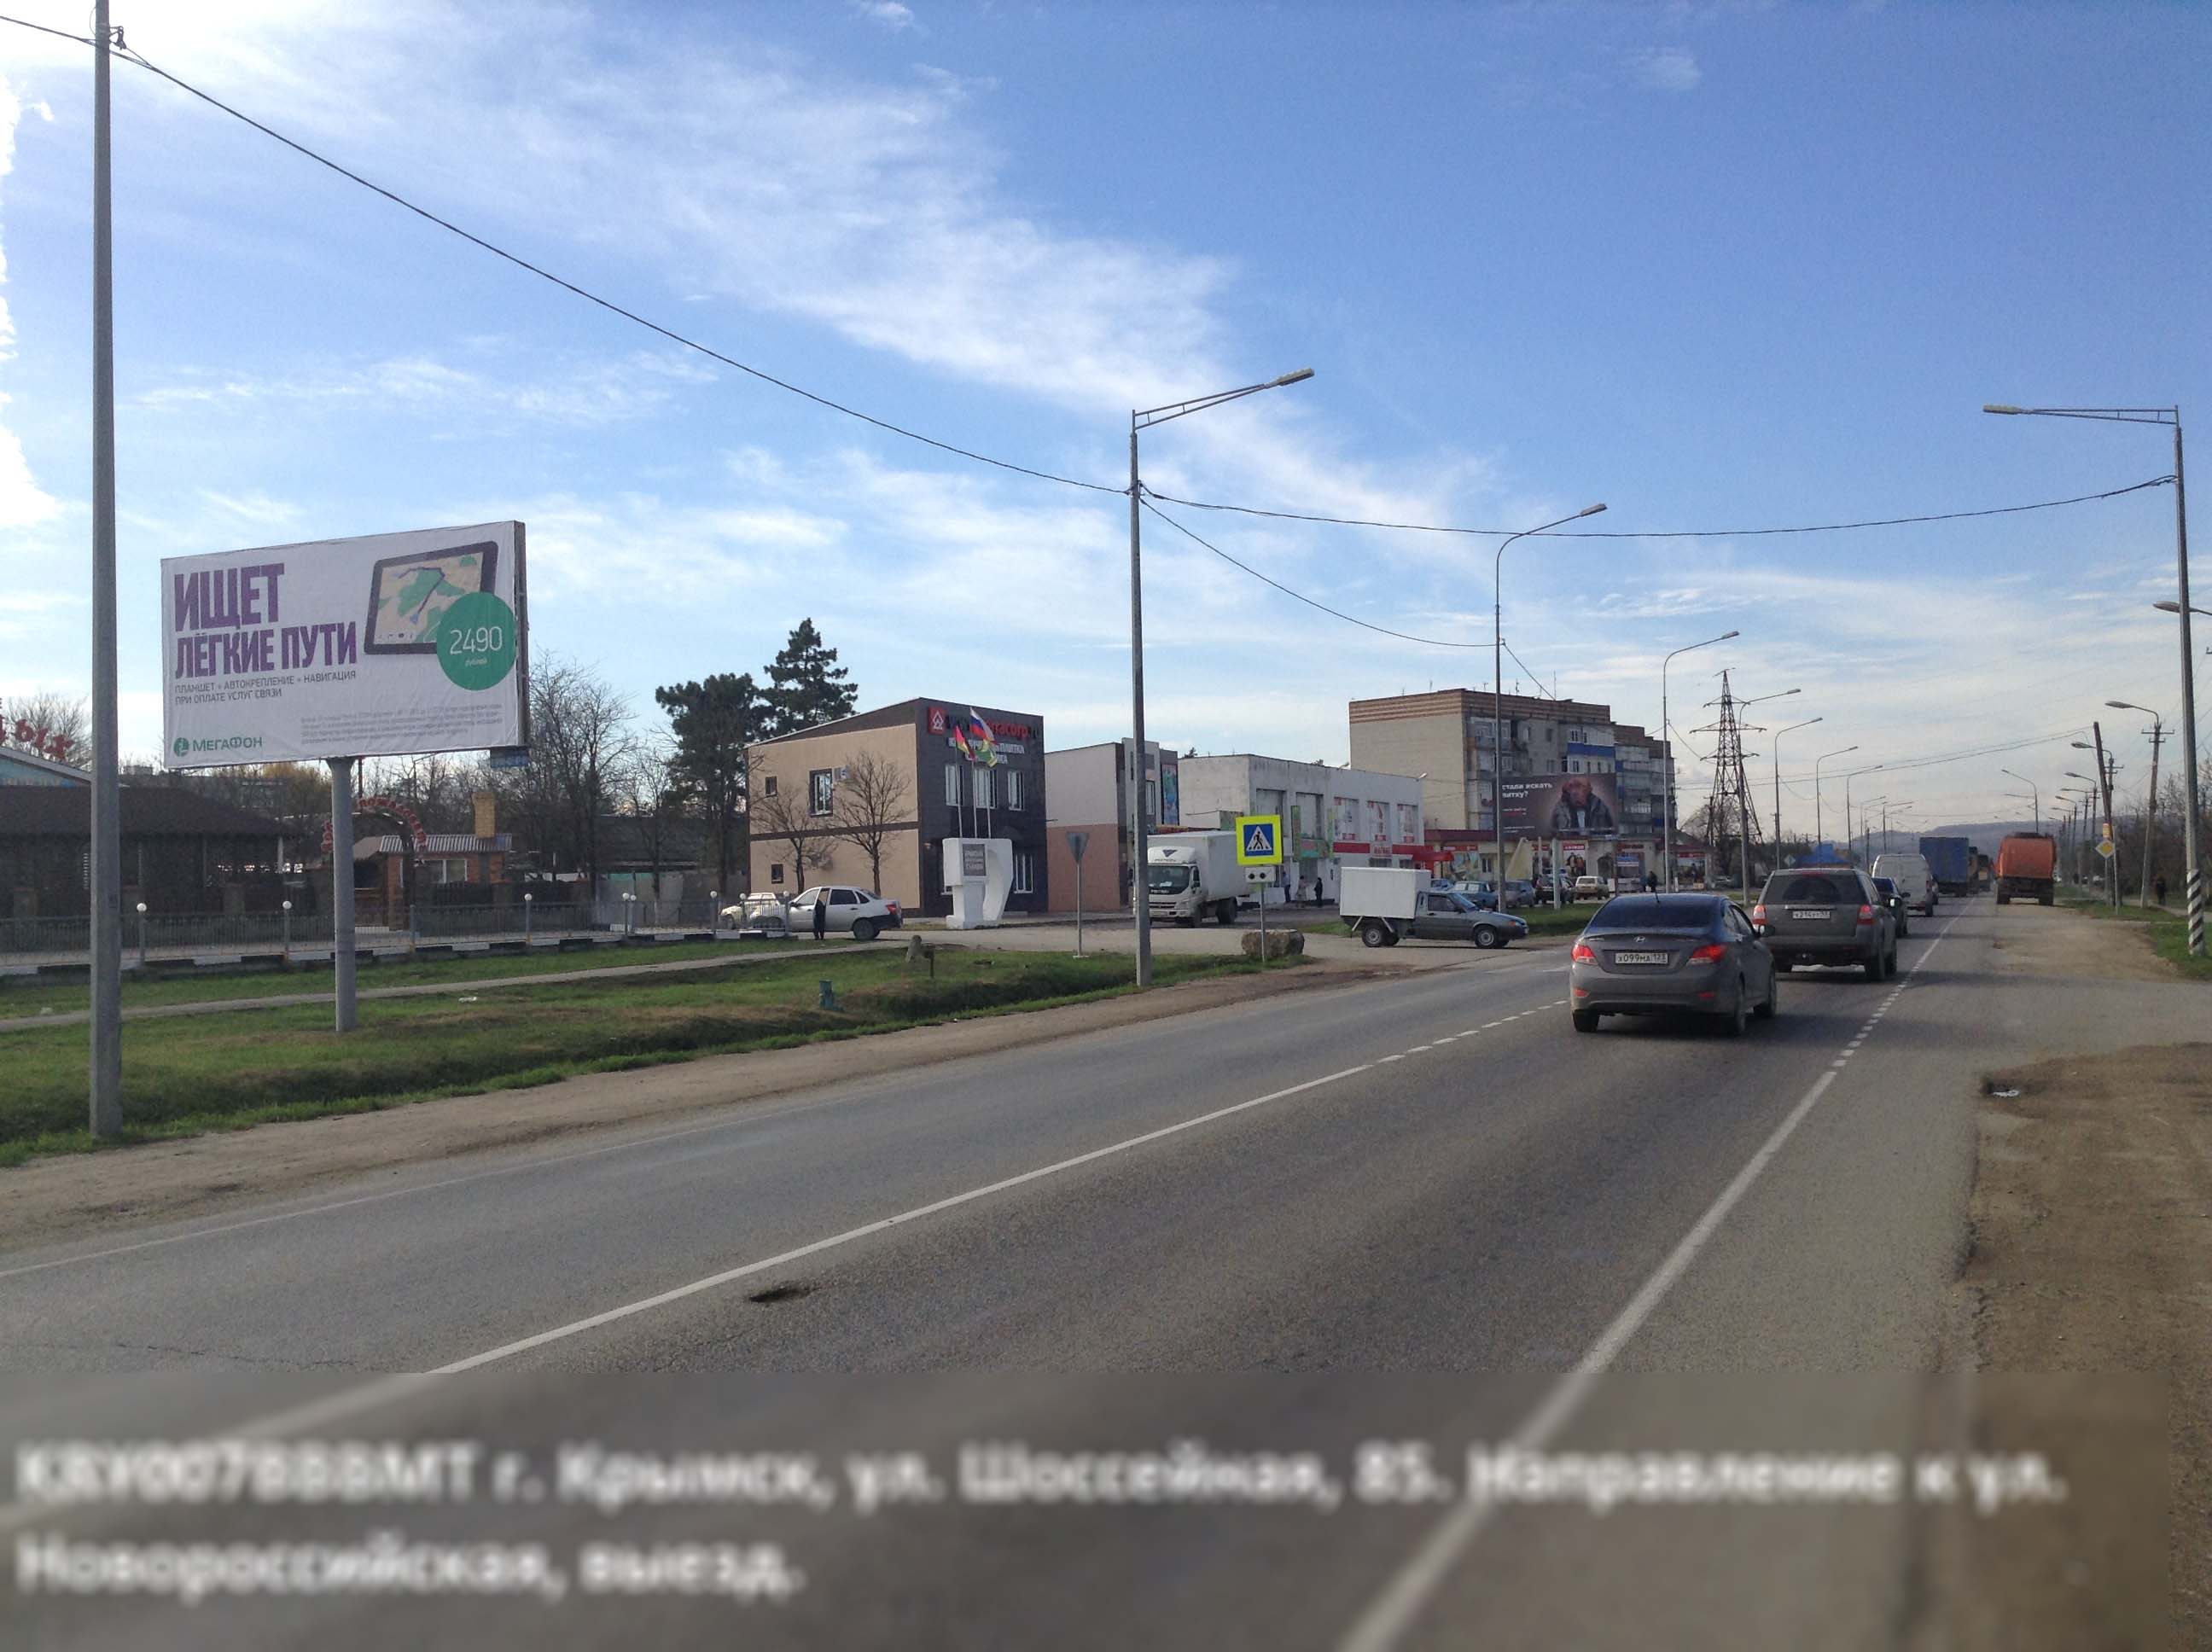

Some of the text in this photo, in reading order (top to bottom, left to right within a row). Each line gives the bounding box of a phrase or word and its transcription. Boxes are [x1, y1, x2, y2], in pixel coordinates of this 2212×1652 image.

[174, 562, 285, 632] ИЩЕТ
[175, 621, 358, 679] ЛЁГКИЕ ПУТИ
[450, 626, 503, 654] 2490
[175, 683, 214, 694] ПЛАНШЕТ
[224, 675, 294, 690] АВТОКРЕПЛЕНИЕ
[304, 670, 357, 683] НАВИГАЦИЯ
[175, 688, 282, 706] ПРИ ОПЛАТЕ УСЛУГ СВЯЗИ
